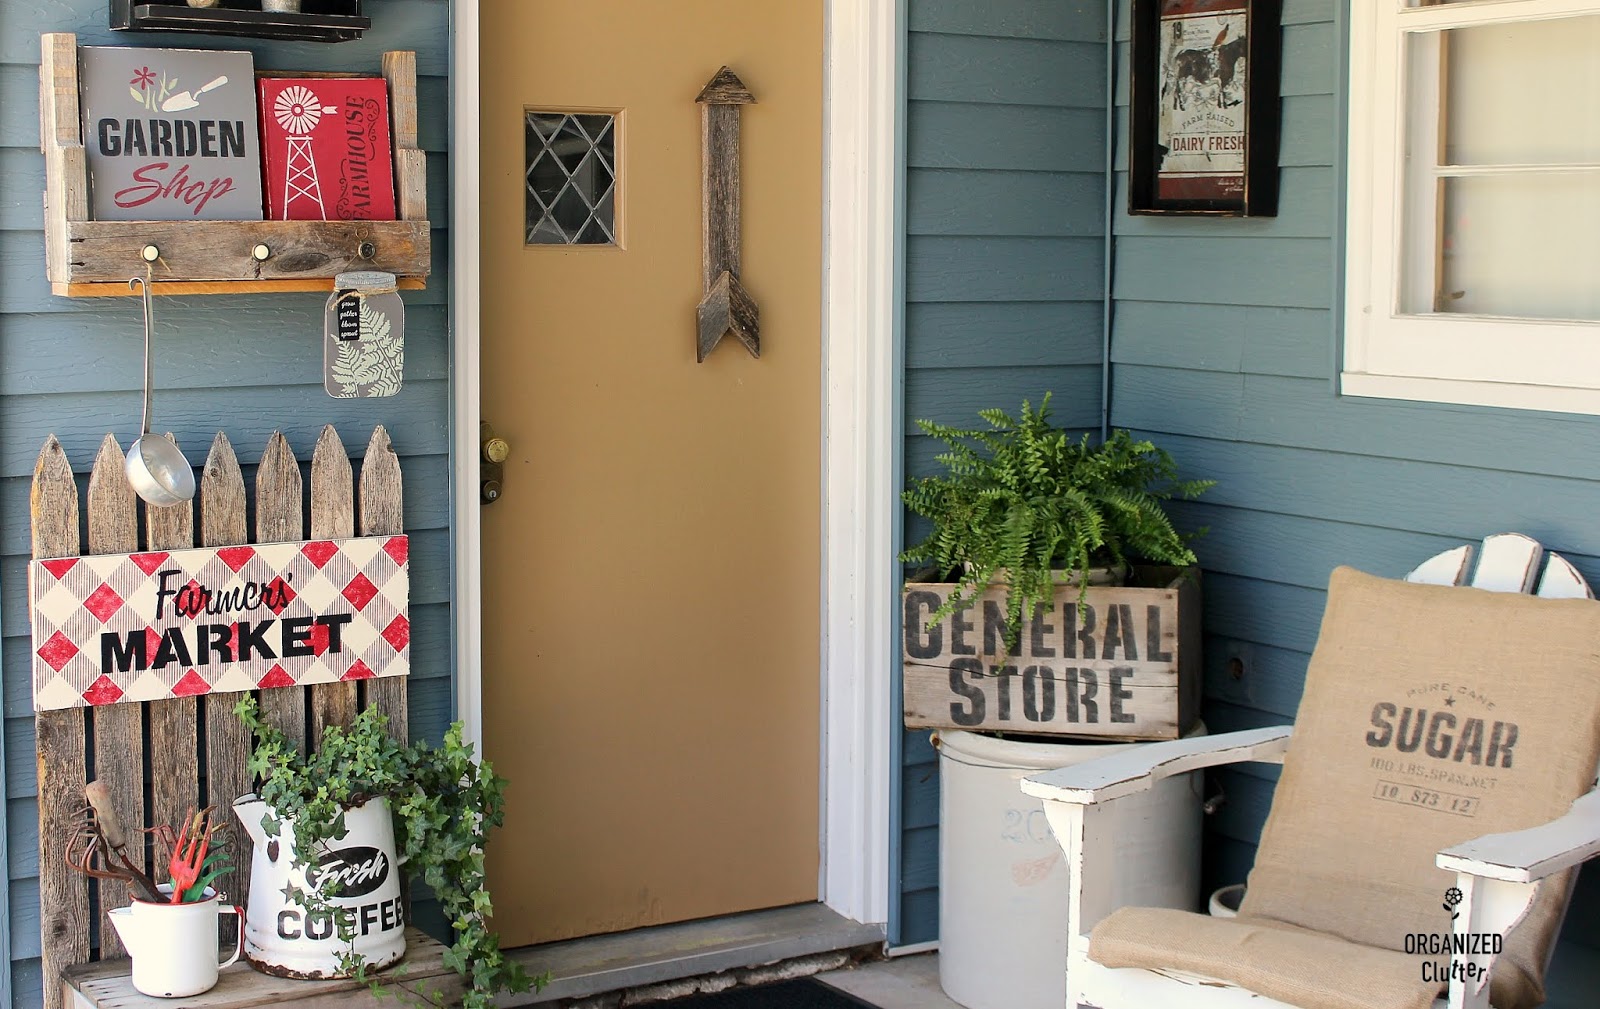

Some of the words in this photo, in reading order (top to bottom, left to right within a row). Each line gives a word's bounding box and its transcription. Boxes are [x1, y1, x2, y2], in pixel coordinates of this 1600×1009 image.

[1173, 22, 1182, 39] 19
[98, 118, 246, 158] GARDEN
[1181, 114, 1203, 130] FARM
[1206, 112, 1235, 127] RAISED
[345, 96, 371, 220] FARMHOUSE
[1173, 137, 1205, 152] DAIRY
[1209, 135, 1245, 151] FRESH
[114, 162, 237, 216] Shop
[340, 310, 358, 320] gather
[101, 613, 352, 674] MARKET
[904, 590, 1173, 663] GENERAL
[949, 657, 1135, 726] STORE
[1407, 682, 1450, 698] PURE
[1457, 686, 1496, 711] CANE
[1365, 702, 1519, 769] SUGAR
[1380, 784, 1399, 799] 10
[1450, 799, 1471, 813] 12
[313, 849, 386, 893] Fresh
